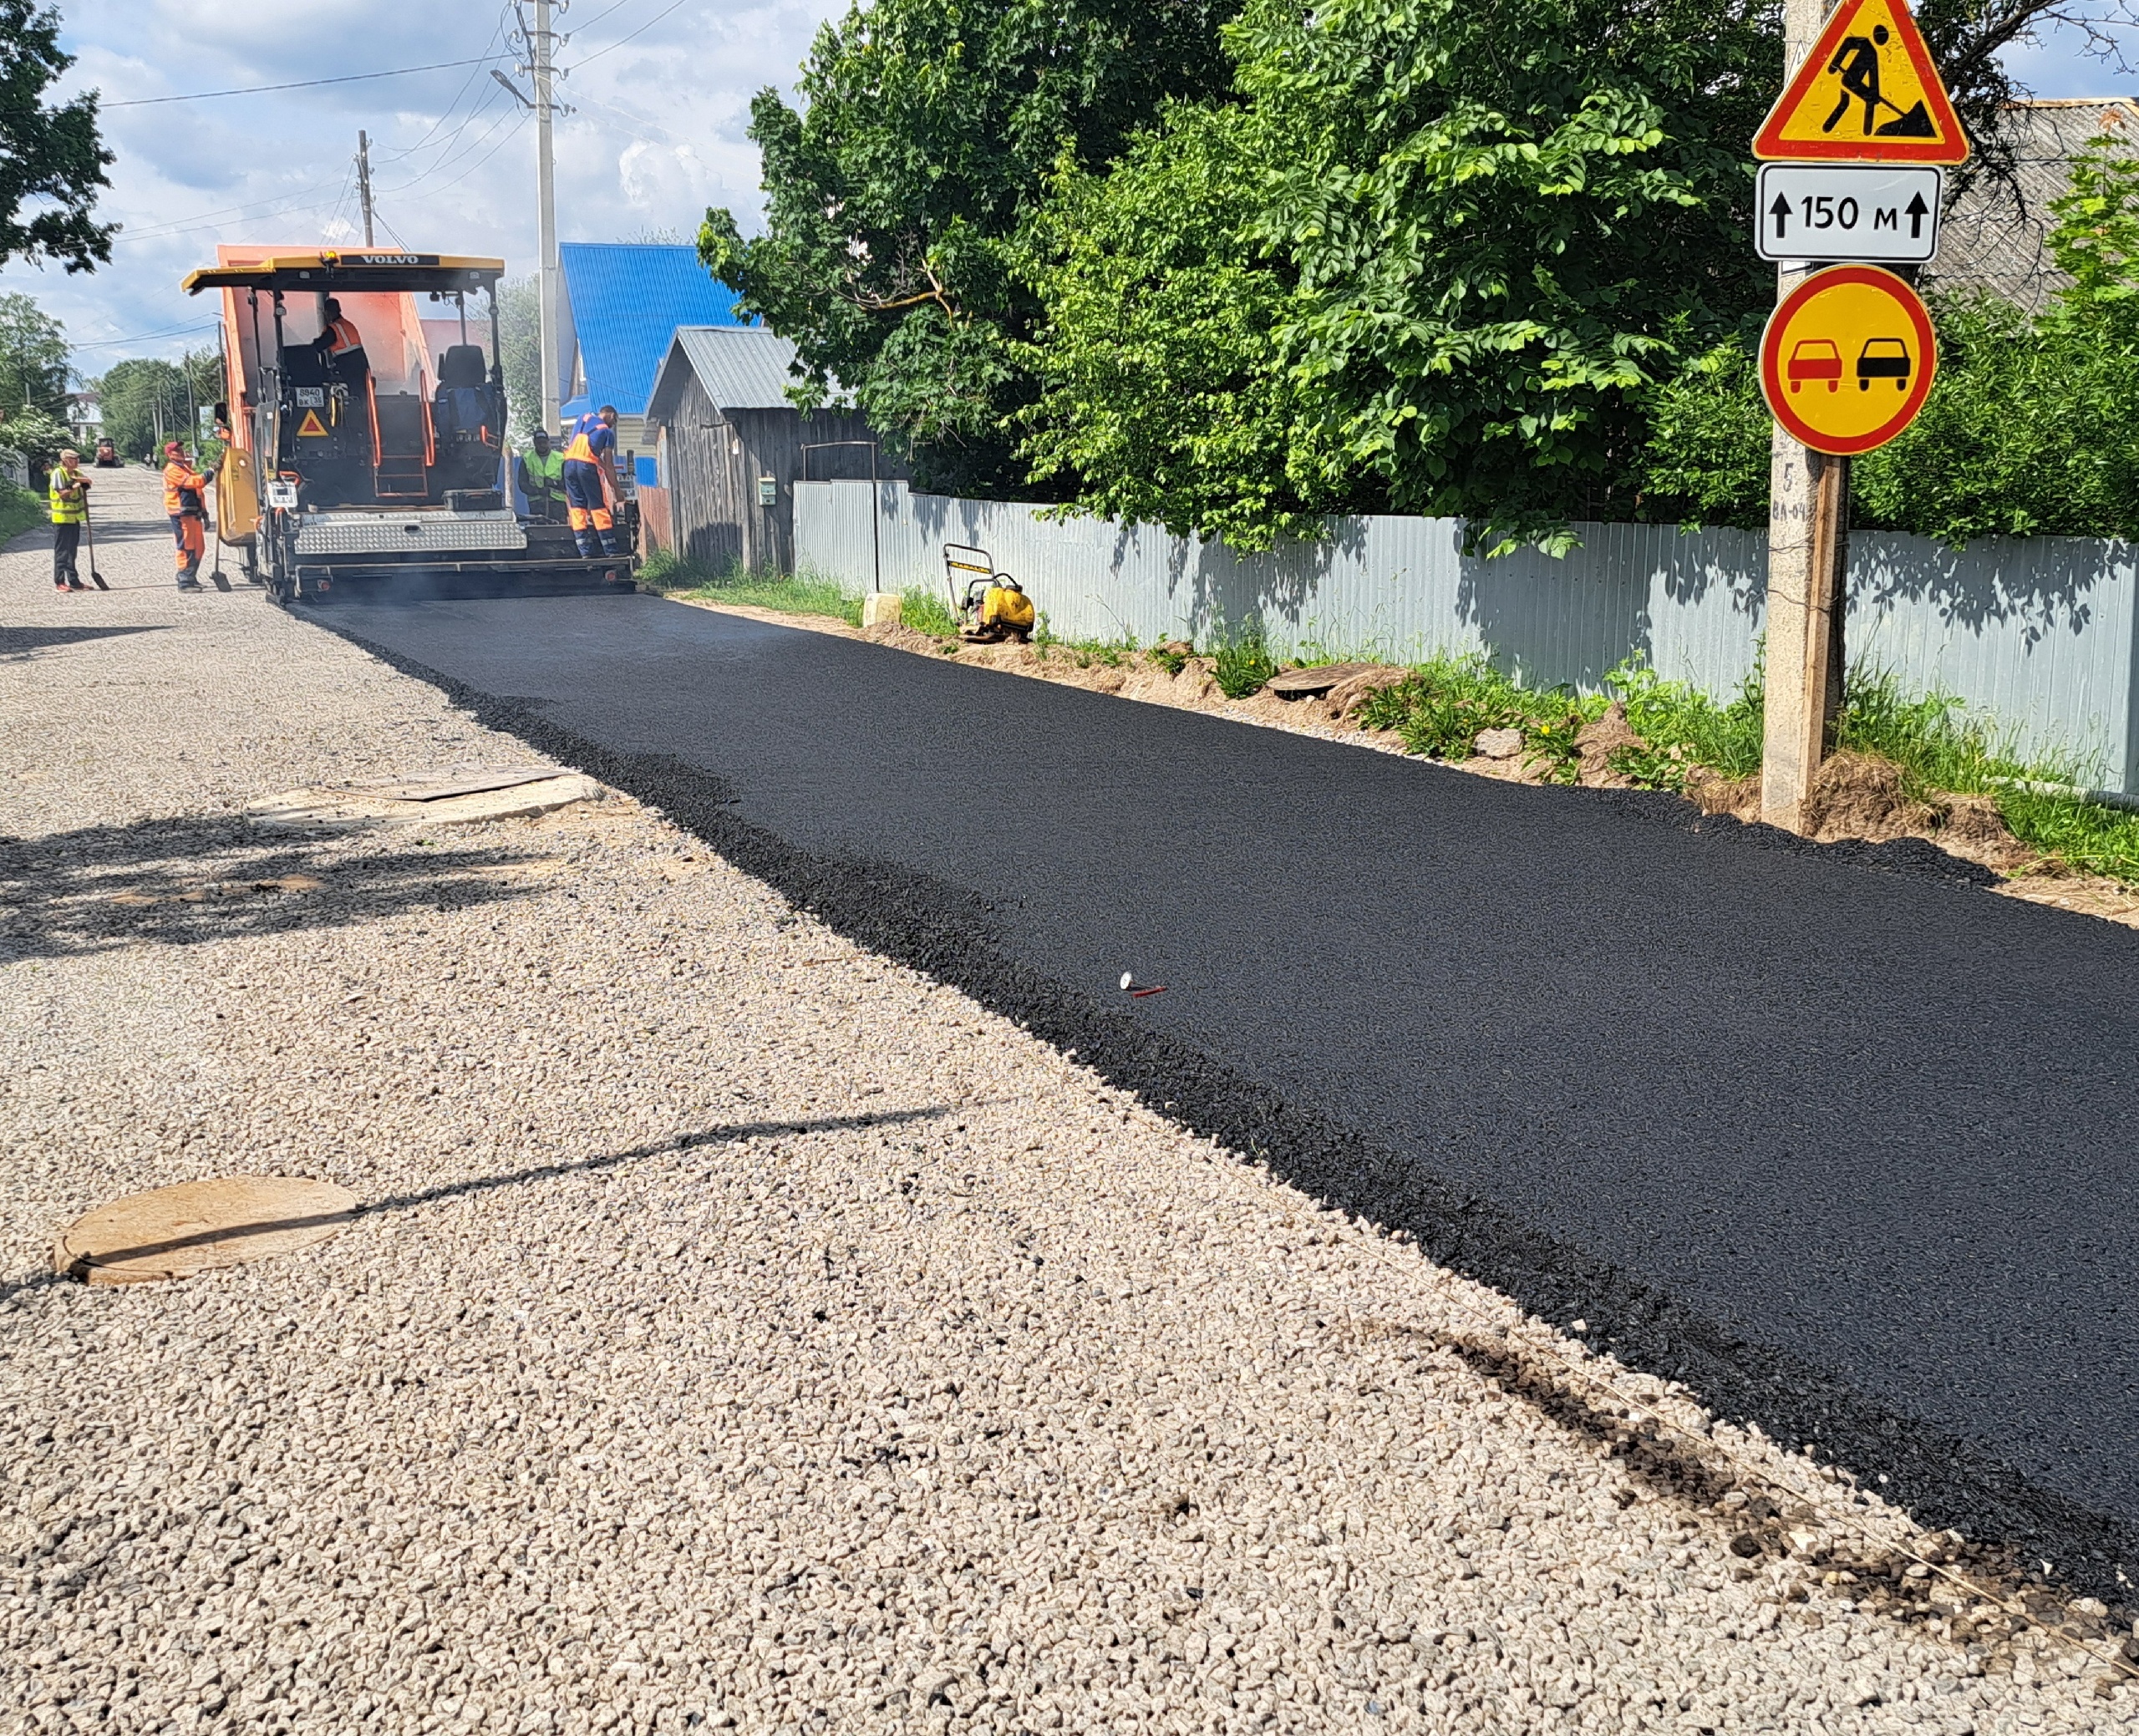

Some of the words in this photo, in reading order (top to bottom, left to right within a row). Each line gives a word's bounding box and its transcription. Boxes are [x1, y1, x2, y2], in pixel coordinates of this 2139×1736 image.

[1801, 195, 1859, 230] 150
[1873, 206, 1898, 231] м
[360, 254, 419, 264] VOLVO
